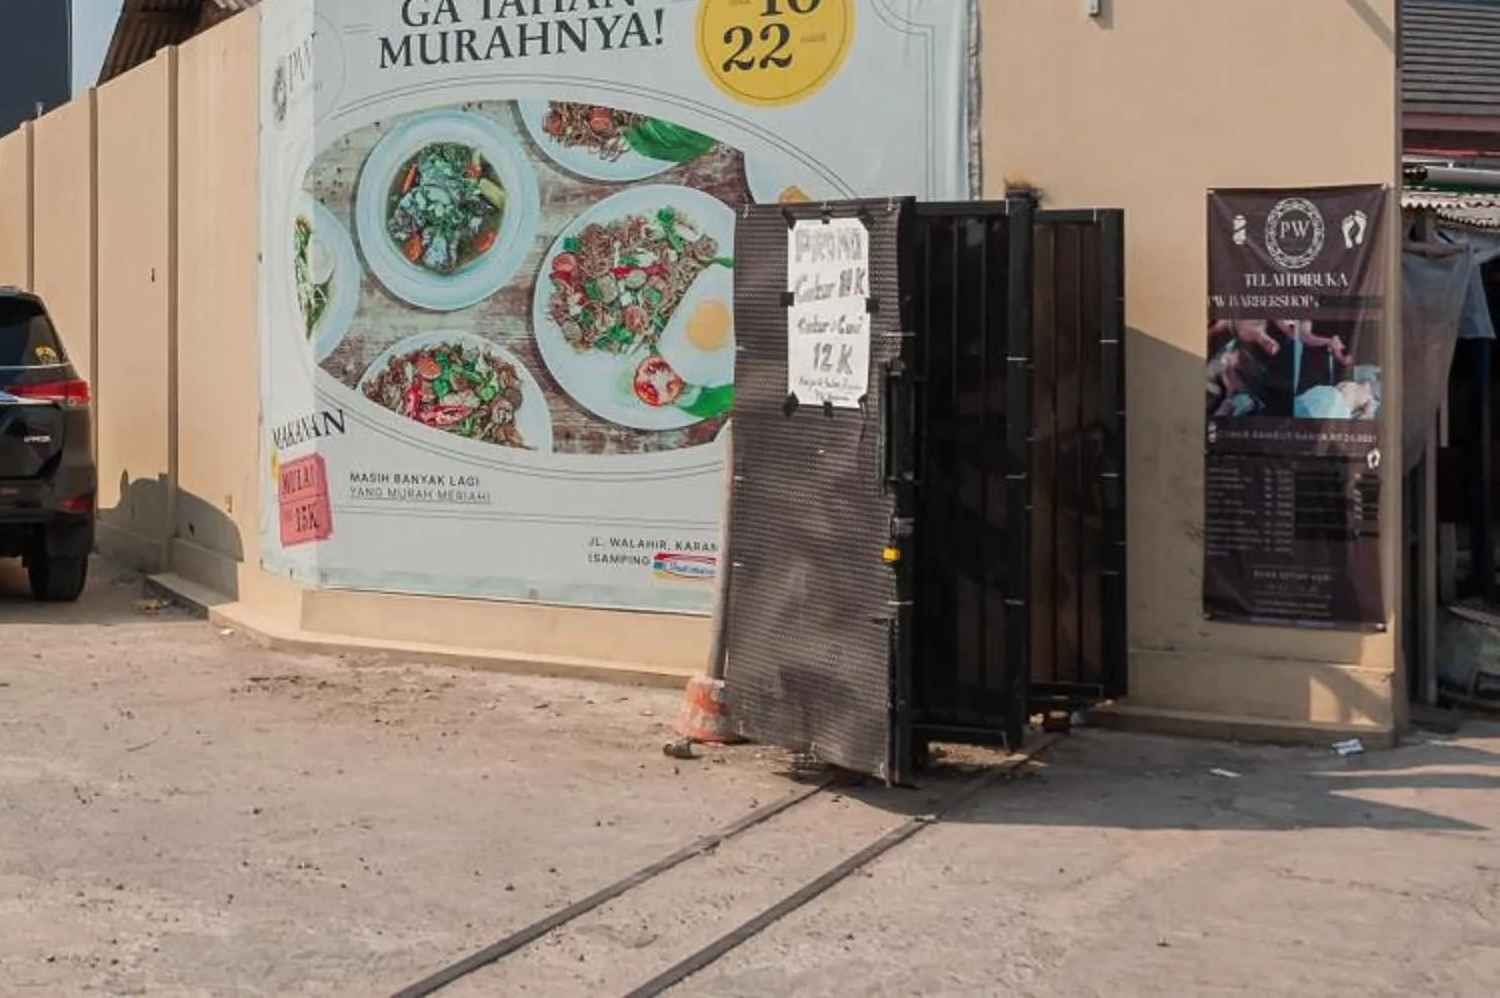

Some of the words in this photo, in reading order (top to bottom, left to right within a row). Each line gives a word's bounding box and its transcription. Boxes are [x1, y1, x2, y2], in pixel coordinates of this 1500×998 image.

[378, 8, 664, 68] MURAHNYA!
[722, 23, 793, 73] 22
[1279, 220, 1310, 239] PW
[350, 473, 389, 483] MASIH
[394, 474, 445, 487] BANYAK
[450, 476, 480, 487] LAGI
[350, 487, 383, 498] YANG
[388, 489, 432, 501] MURAH
